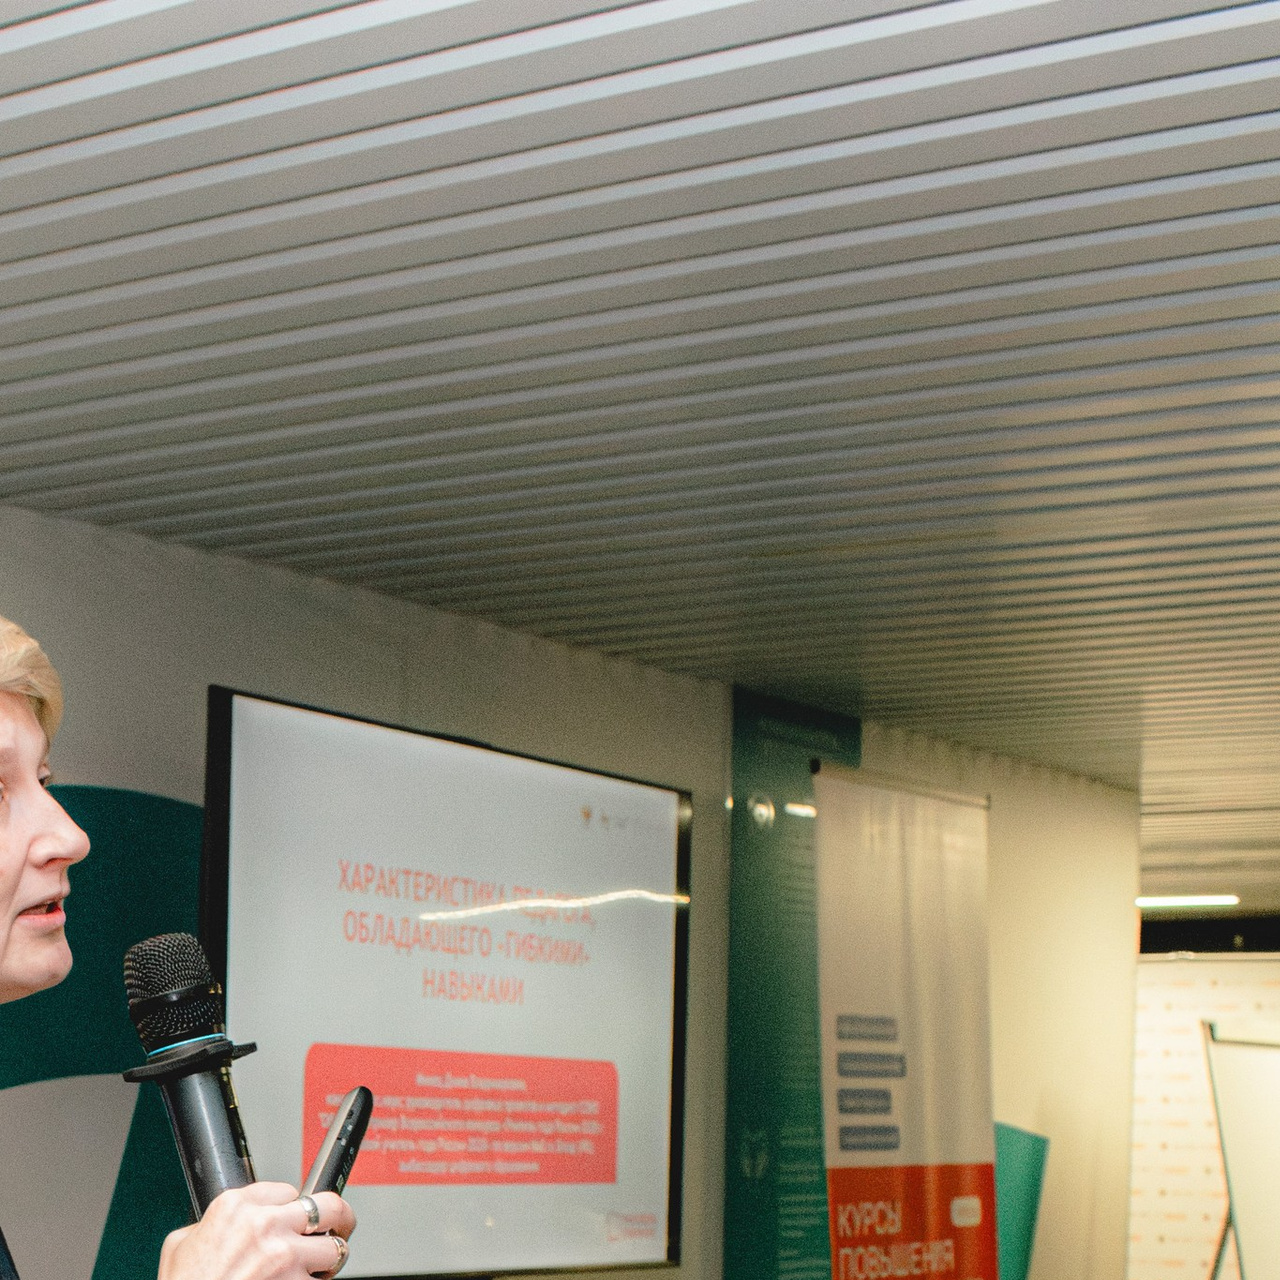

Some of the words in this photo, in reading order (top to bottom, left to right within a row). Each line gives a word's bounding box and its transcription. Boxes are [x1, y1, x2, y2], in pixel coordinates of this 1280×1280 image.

[337, 858, 507, 907] ХАРАКТЕРИСТИКА
[342, 908, 493, 959] ОБЛАДАЮЩЕГО
[422, 966, 525, 1006] НАВЫКАМИ
[837, 1200, 902, 1238] КУРСЫ
